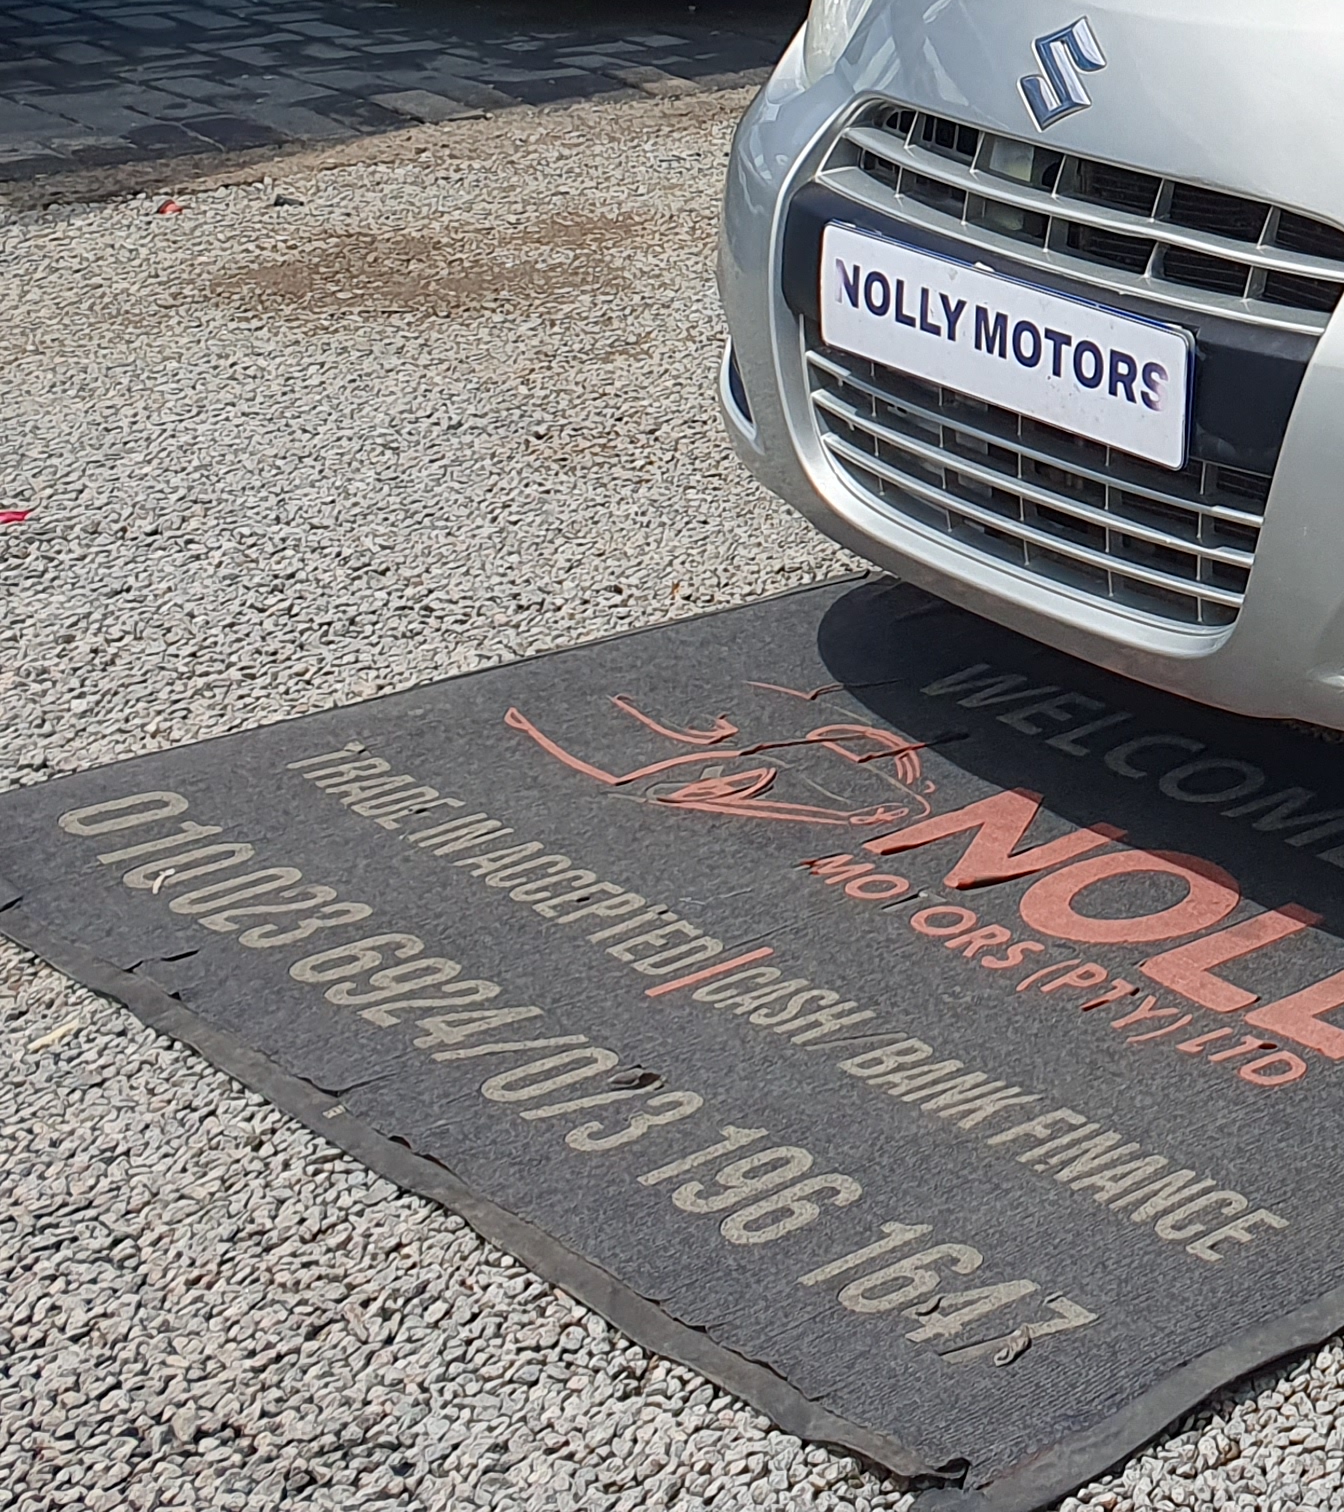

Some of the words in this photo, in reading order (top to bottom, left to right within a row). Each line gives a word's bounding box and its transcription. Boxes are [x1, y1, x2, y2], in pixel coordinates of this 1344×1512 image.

[834, 257, 967, 342] NOLLY
[973, 304, 1169, 412] MOTORS
[285, 740, 467, 831] TRADE
[406, 811, 515, 857] IN
[987, 1106, 1290, 1262] FINANCE
[636, 1123, 863, 1246] 196
[799, 1220, 1100, 1367] 1647
